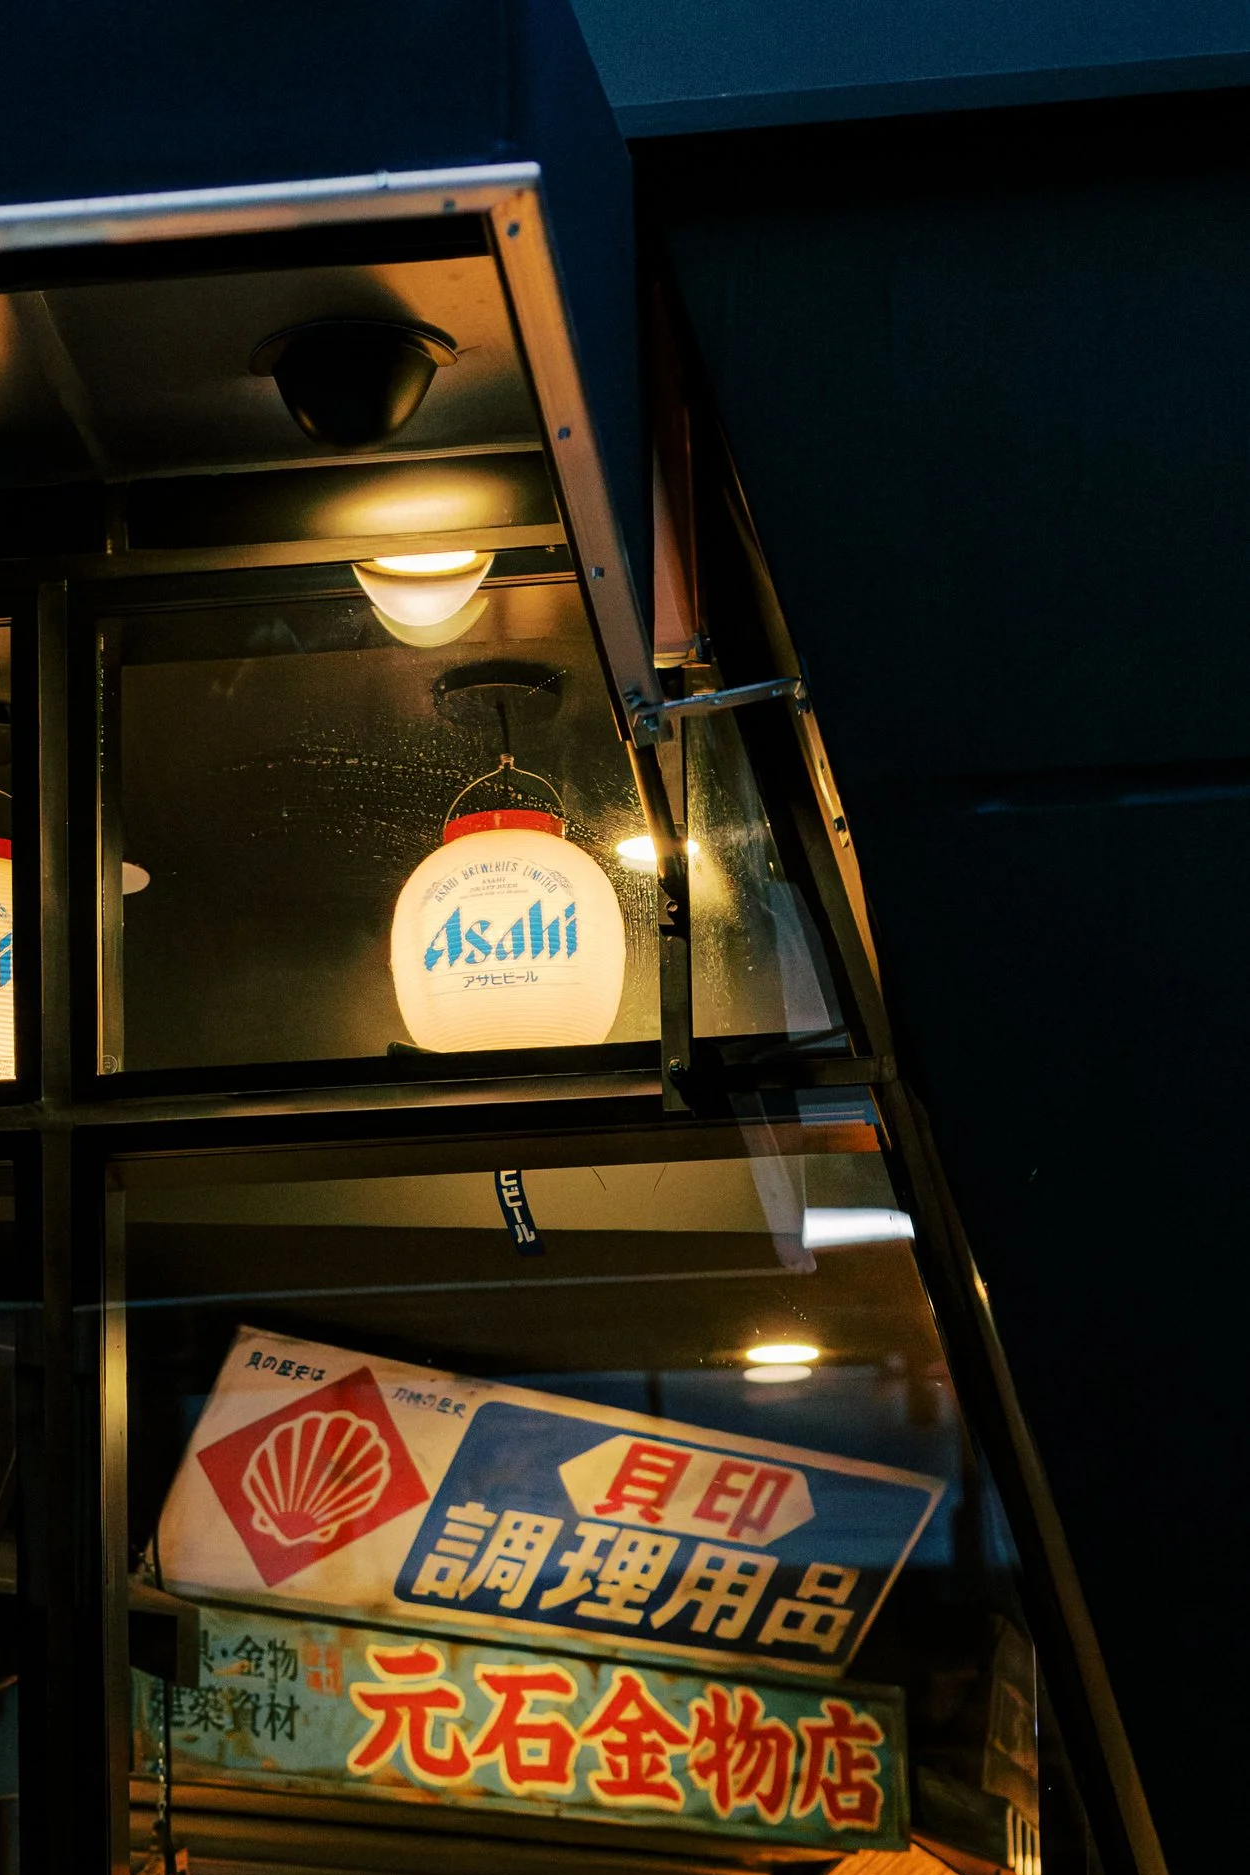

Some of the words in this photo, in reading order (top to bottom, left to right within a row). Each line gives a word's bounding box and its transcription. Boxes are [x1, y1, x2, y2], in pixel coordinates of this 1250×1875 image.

[461, 861, 519, 882] BREWERIES
[523, 864, 559, 894] LIMITED
[424, 899, 579, 972] Asahi
[463, 970, 539, 989] アサヒビール
[245, 1350, 327, 1382] 貝の歴史は
[593, 1440, 796, 1545] 貝印
[410, 1500, 863, 1657] 調理用品
[347, 1641, 889, 1834] 元石金物店
